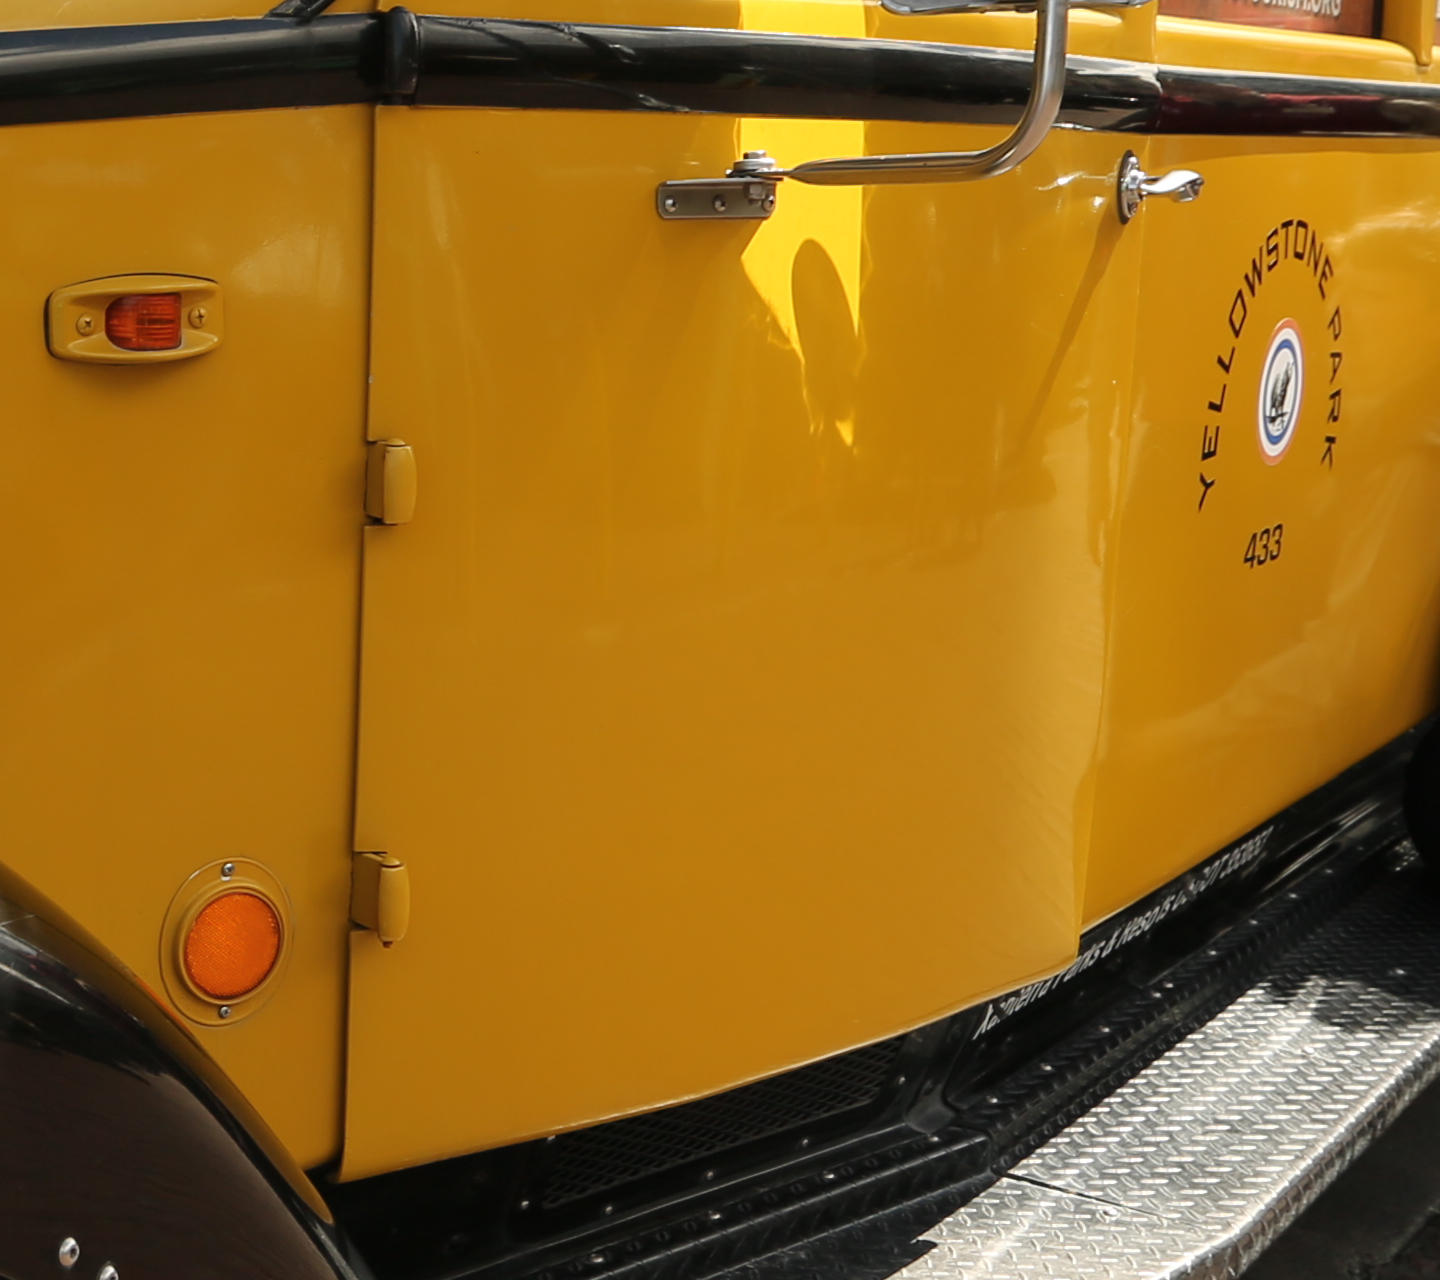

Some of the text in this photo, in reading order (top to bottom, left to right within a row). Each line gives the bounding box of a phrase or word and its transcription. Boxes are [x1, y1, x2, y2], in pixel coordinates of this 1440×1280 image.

[1198, 219, 1343, 512] YELLOWSTONE PARK
[1243, 523, 1284, 569] 433
